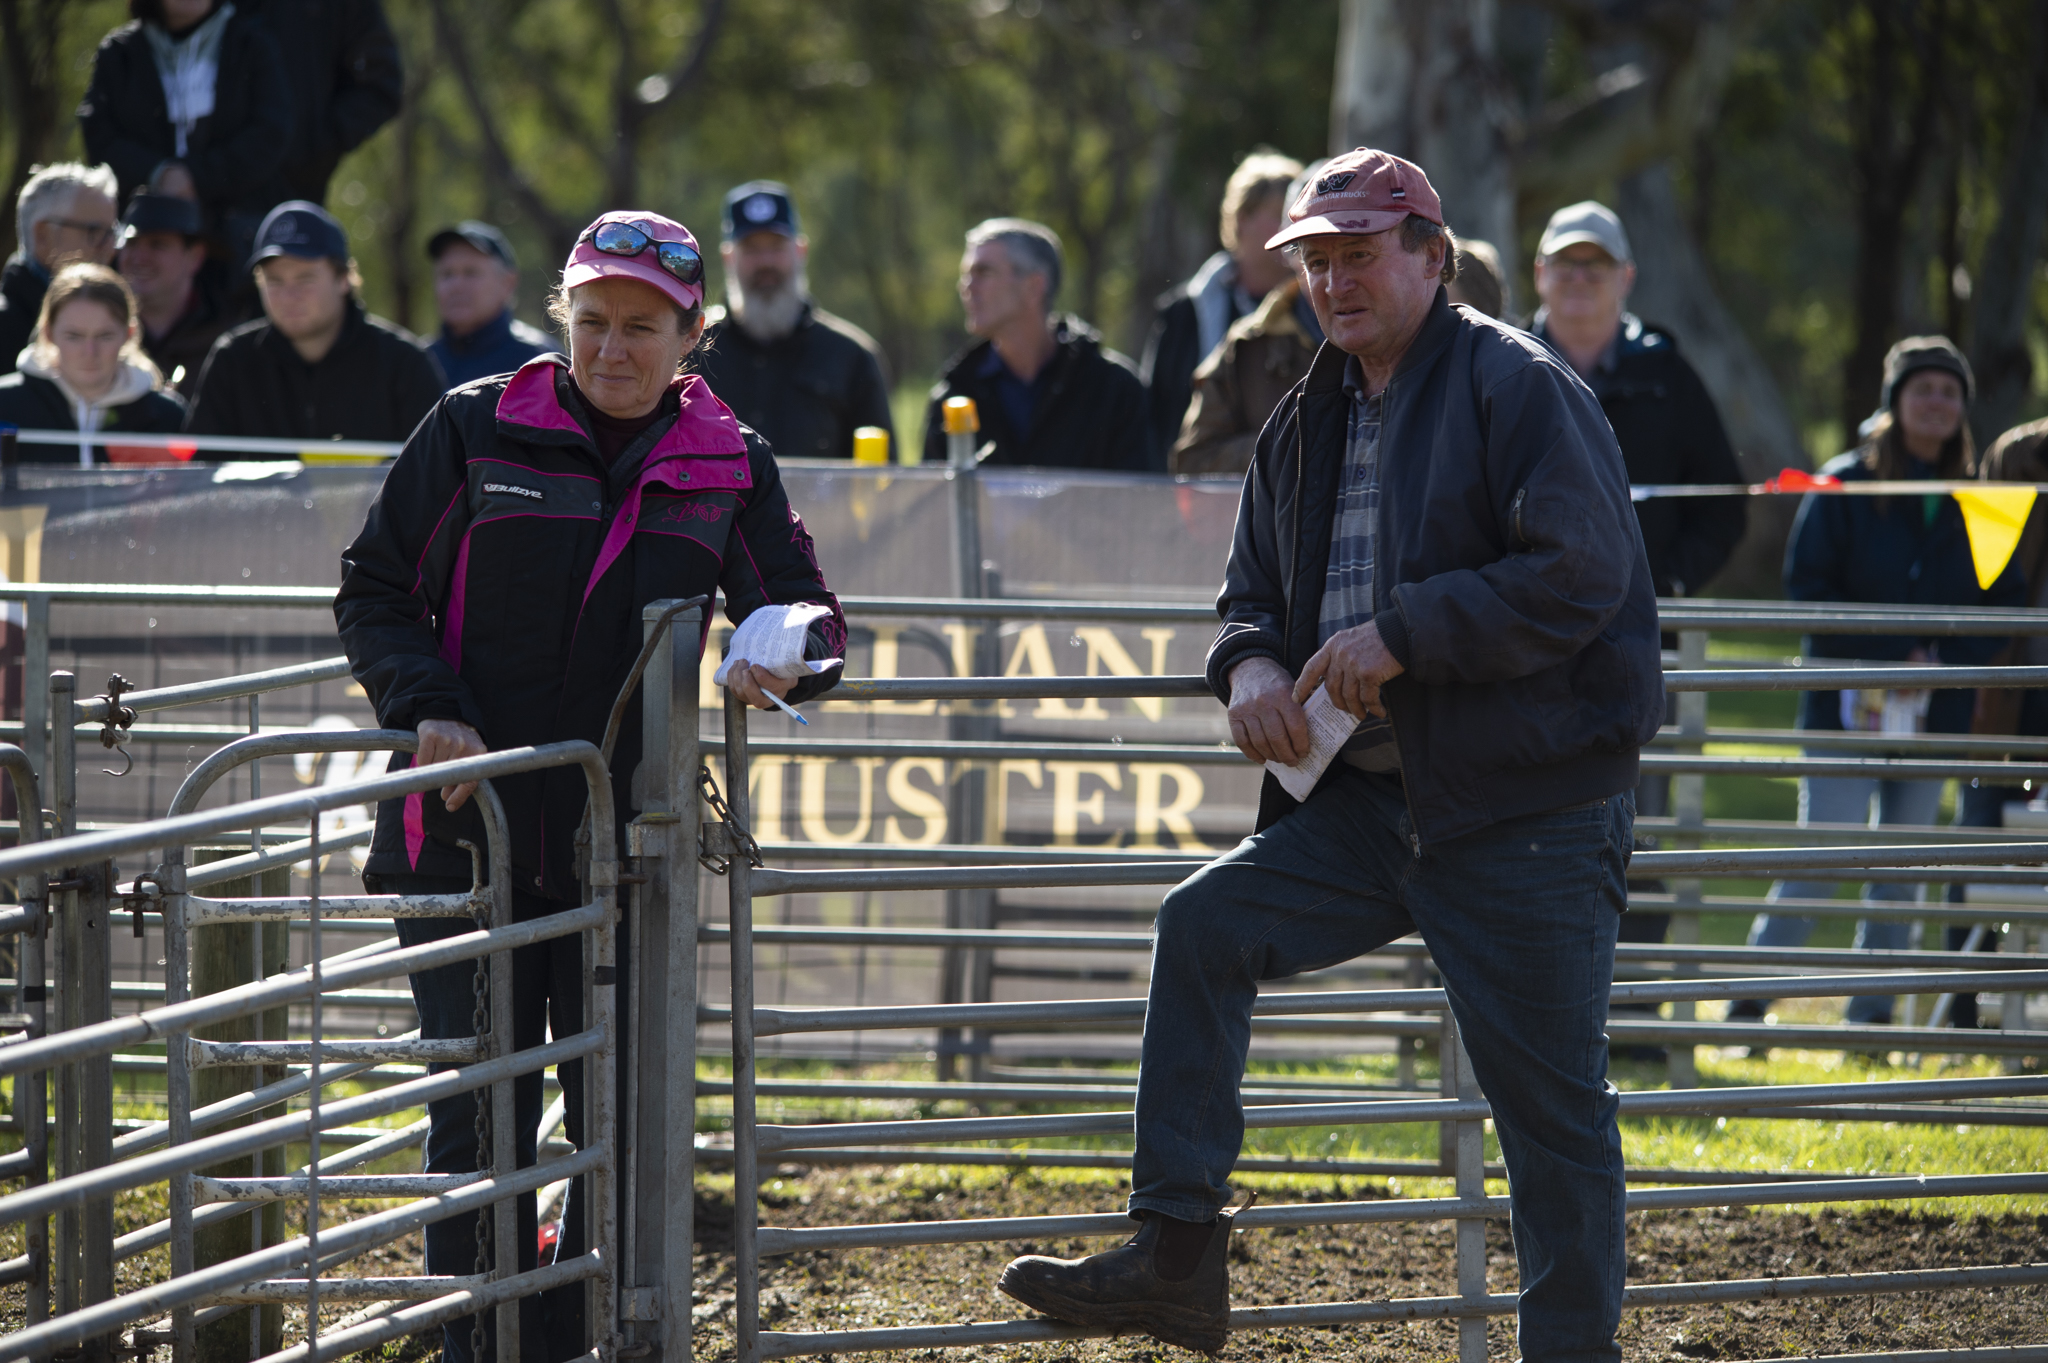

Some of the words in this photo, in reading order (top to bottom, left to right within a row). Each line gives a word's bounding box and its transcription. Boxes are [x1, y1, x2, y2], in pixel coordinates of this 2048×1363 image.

[1324, 192, 1340, 200] STAR
[1340, 190, 1366, 199] TRUCKS
[703, 755, 1214, 854] MUSTER
